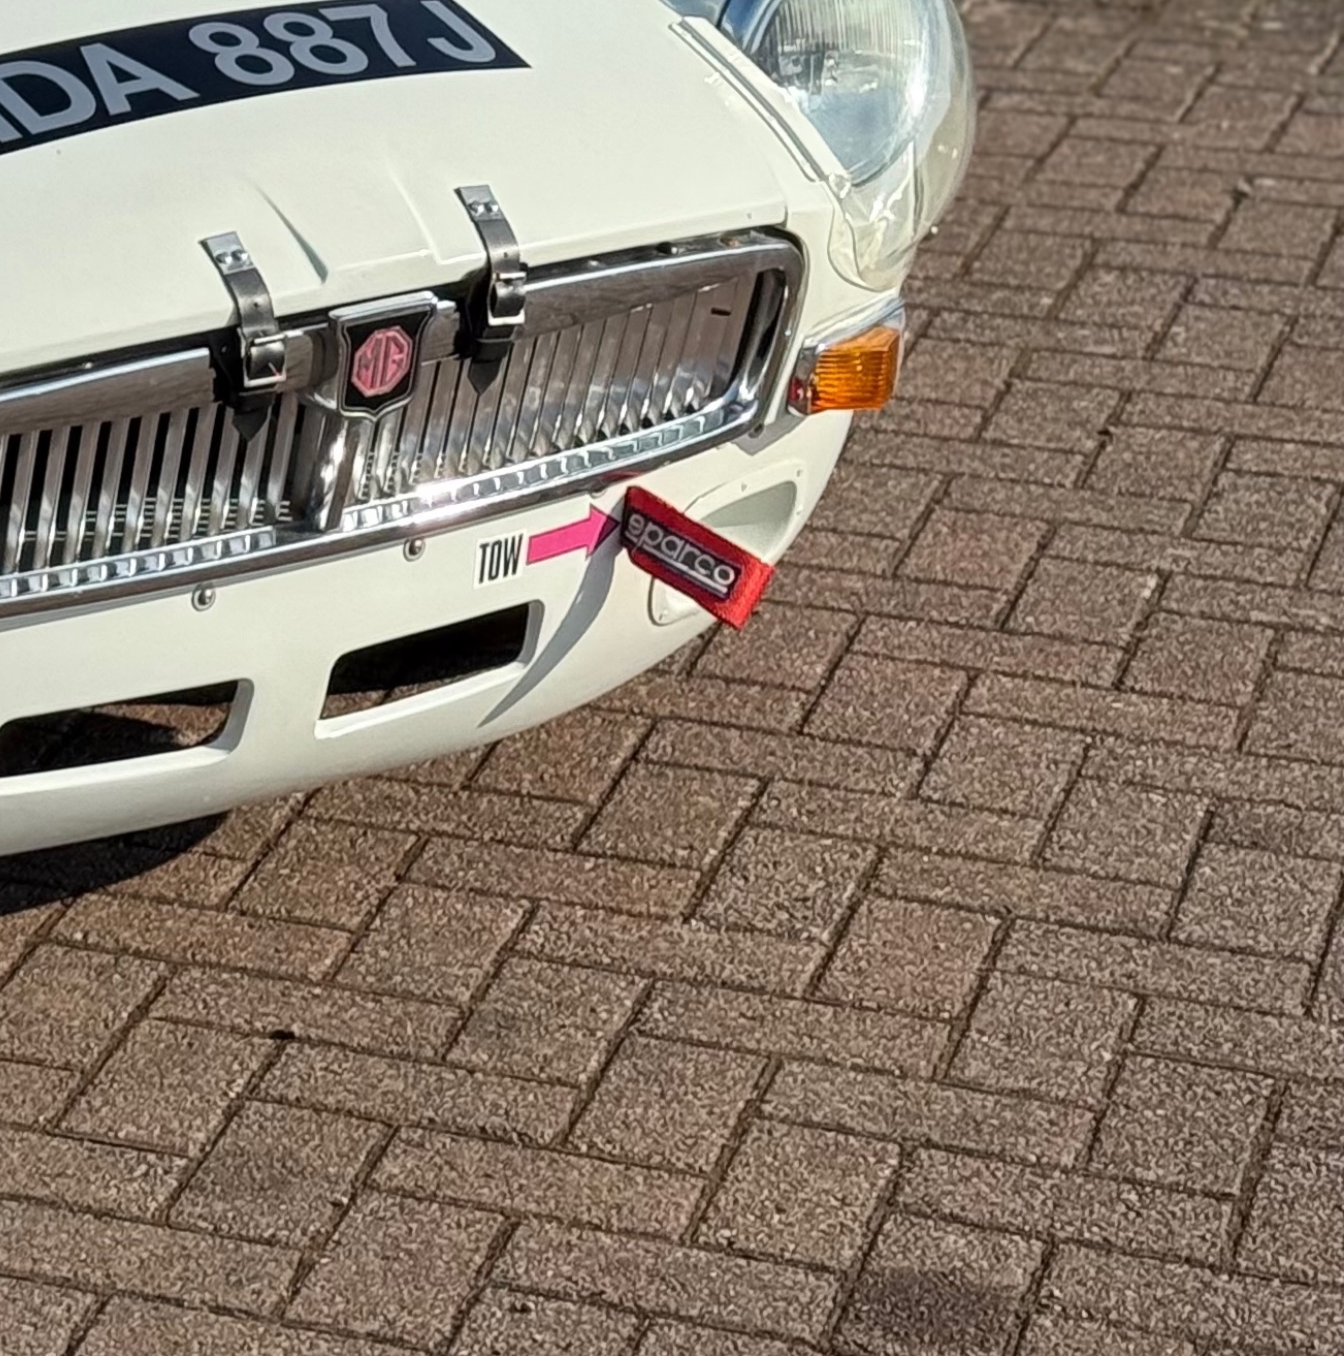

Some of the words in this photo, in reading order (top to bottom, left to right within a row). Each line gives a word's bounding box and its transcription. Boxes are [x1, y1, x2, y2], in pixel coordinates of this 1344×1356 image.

[188, 0, 498, 86] 887J
[352, 326, 412, 397] MG
[479, 533, 524, 585] TOW
[626, 513, 736, 590] sparco
